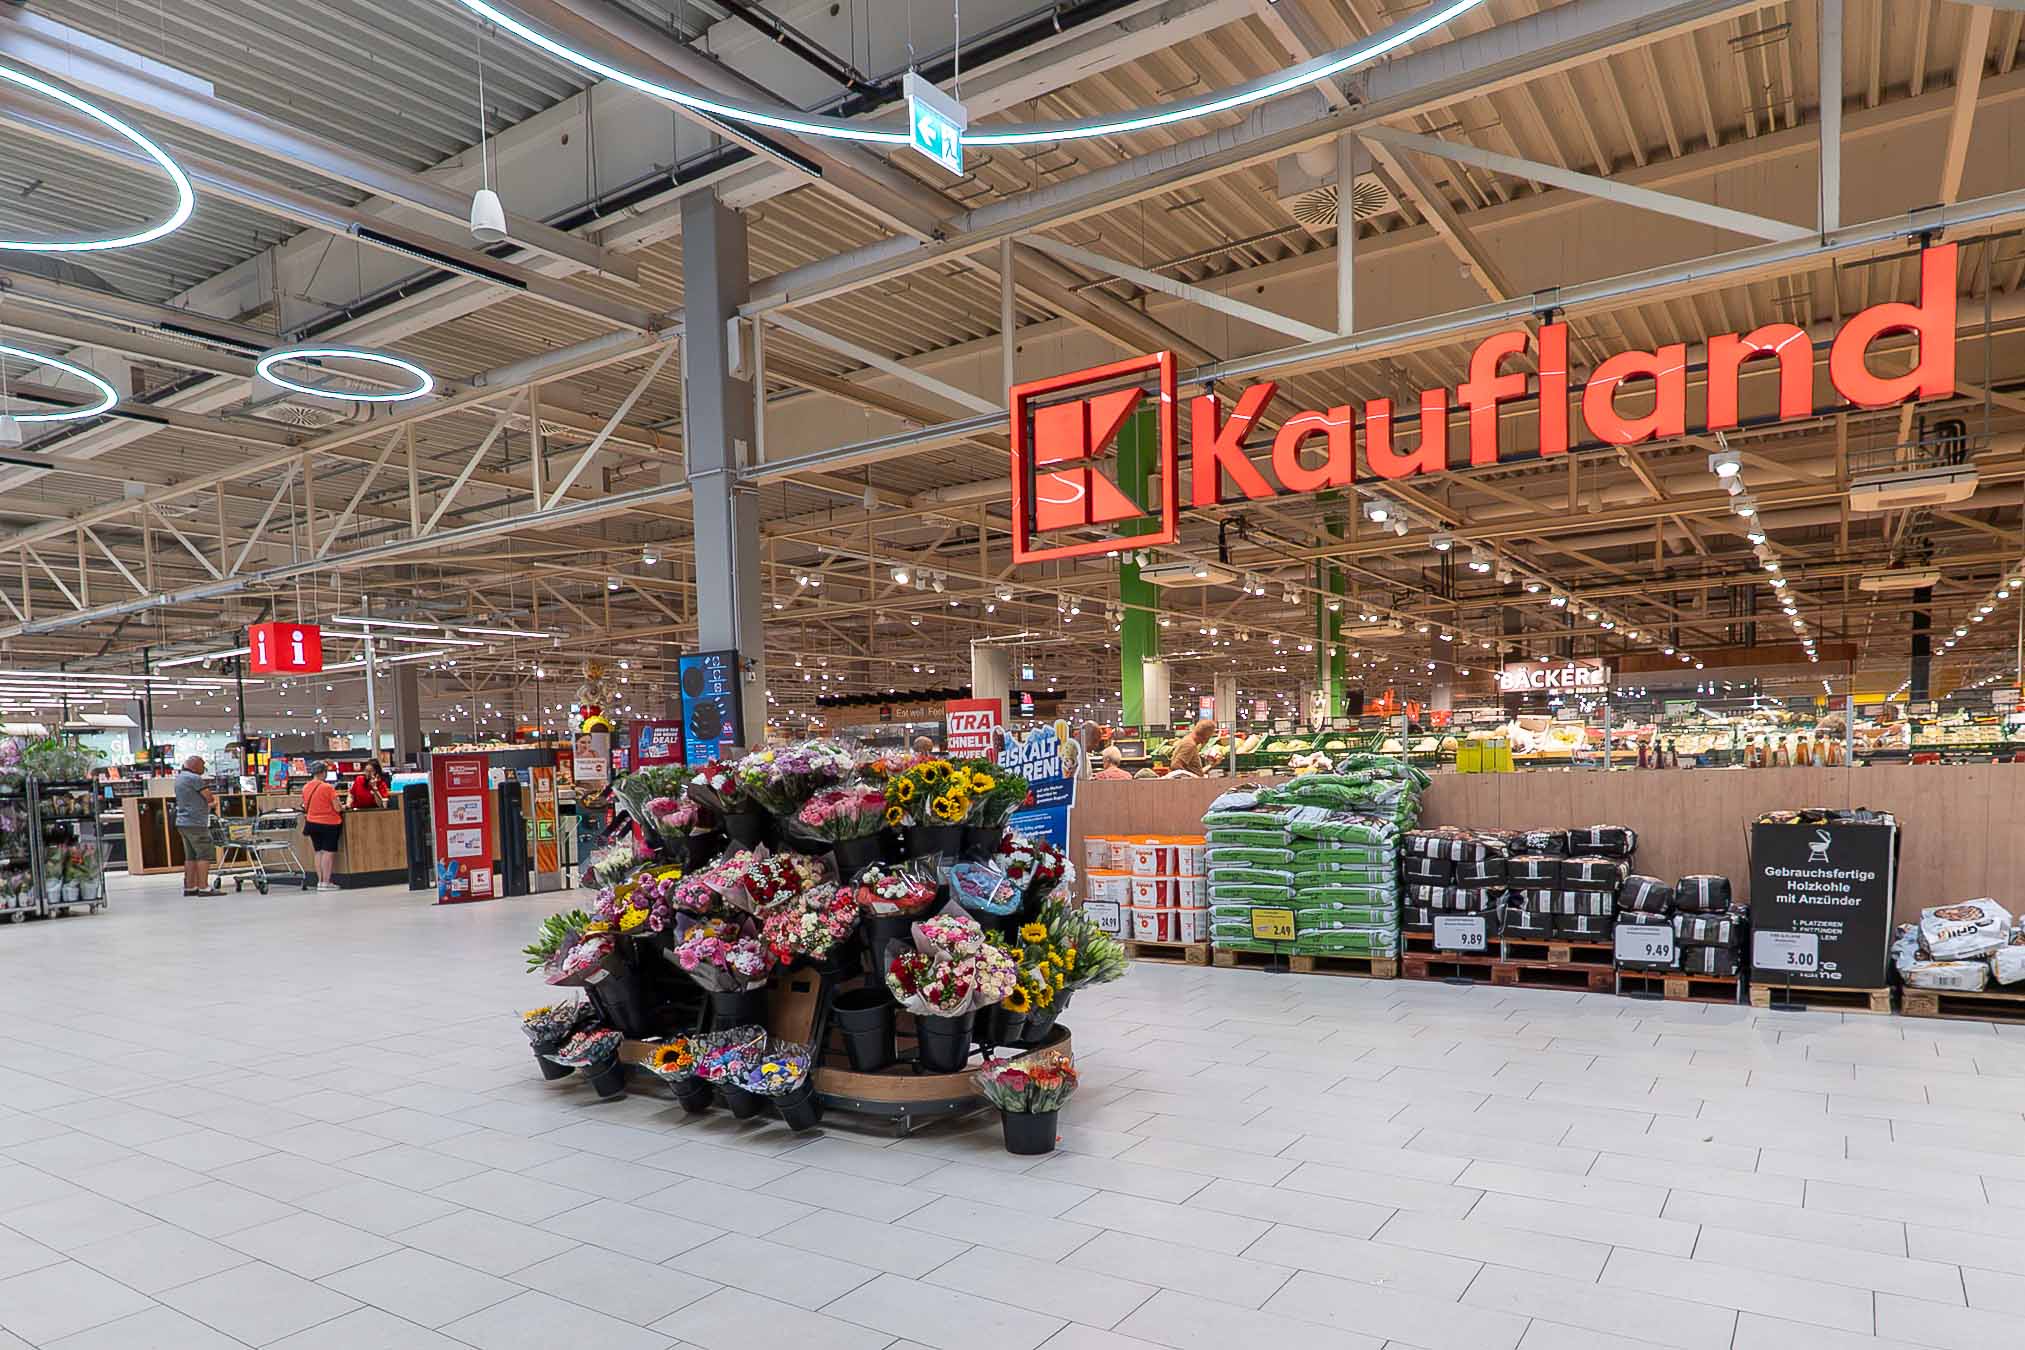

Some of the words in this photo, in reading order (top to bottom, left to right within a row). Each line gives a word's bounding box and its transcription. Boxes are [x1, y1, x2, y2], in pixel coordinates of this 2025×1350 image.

[1192, 243, 1958, 507] Kaufland
[998, 737, 1058, 769] EISKALT
[1764, 866, 1876, 881] Gebrauchsfertige
[1787, 880, 1851, 893] Holzkohle
[1776, 893, 1796, 904] mit
[1798, 894, 1862, 906] Anzünder
[1800, 919, 1843, 928] PLATZIEREN
[1273, 925, 1291, 936] 2.49
[1461, 934, 1483, 945] 9.89
[1645, 944, 1670, 957] 9.49
[1786, 951, 1814, 966] 3.00
